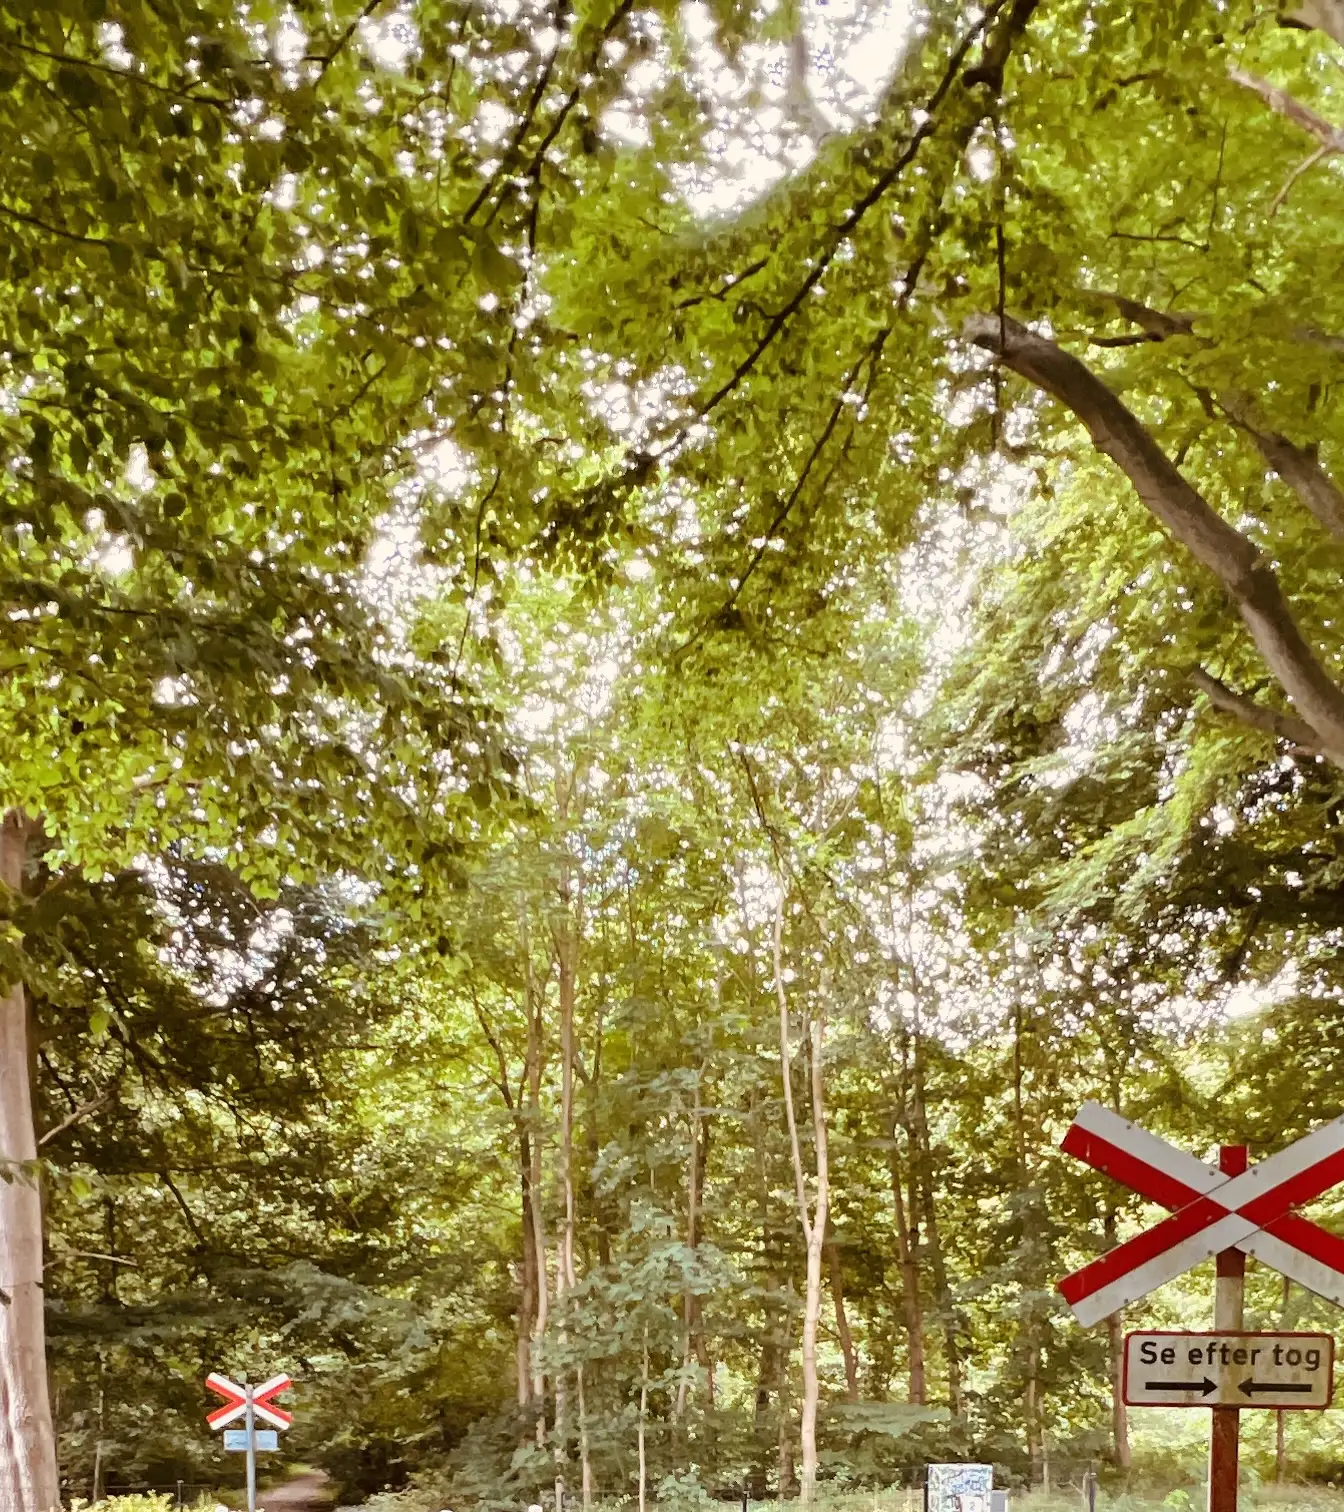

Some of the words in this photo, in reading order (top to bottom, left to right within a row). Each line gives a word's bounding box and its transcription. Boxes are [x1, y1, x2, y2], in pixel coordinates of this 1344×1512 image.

[1140, 1341, 1176, 1365] Se
[1188, 1341, 1261, 1366] efter
[1273, 1343, 1321, 1371] tog
